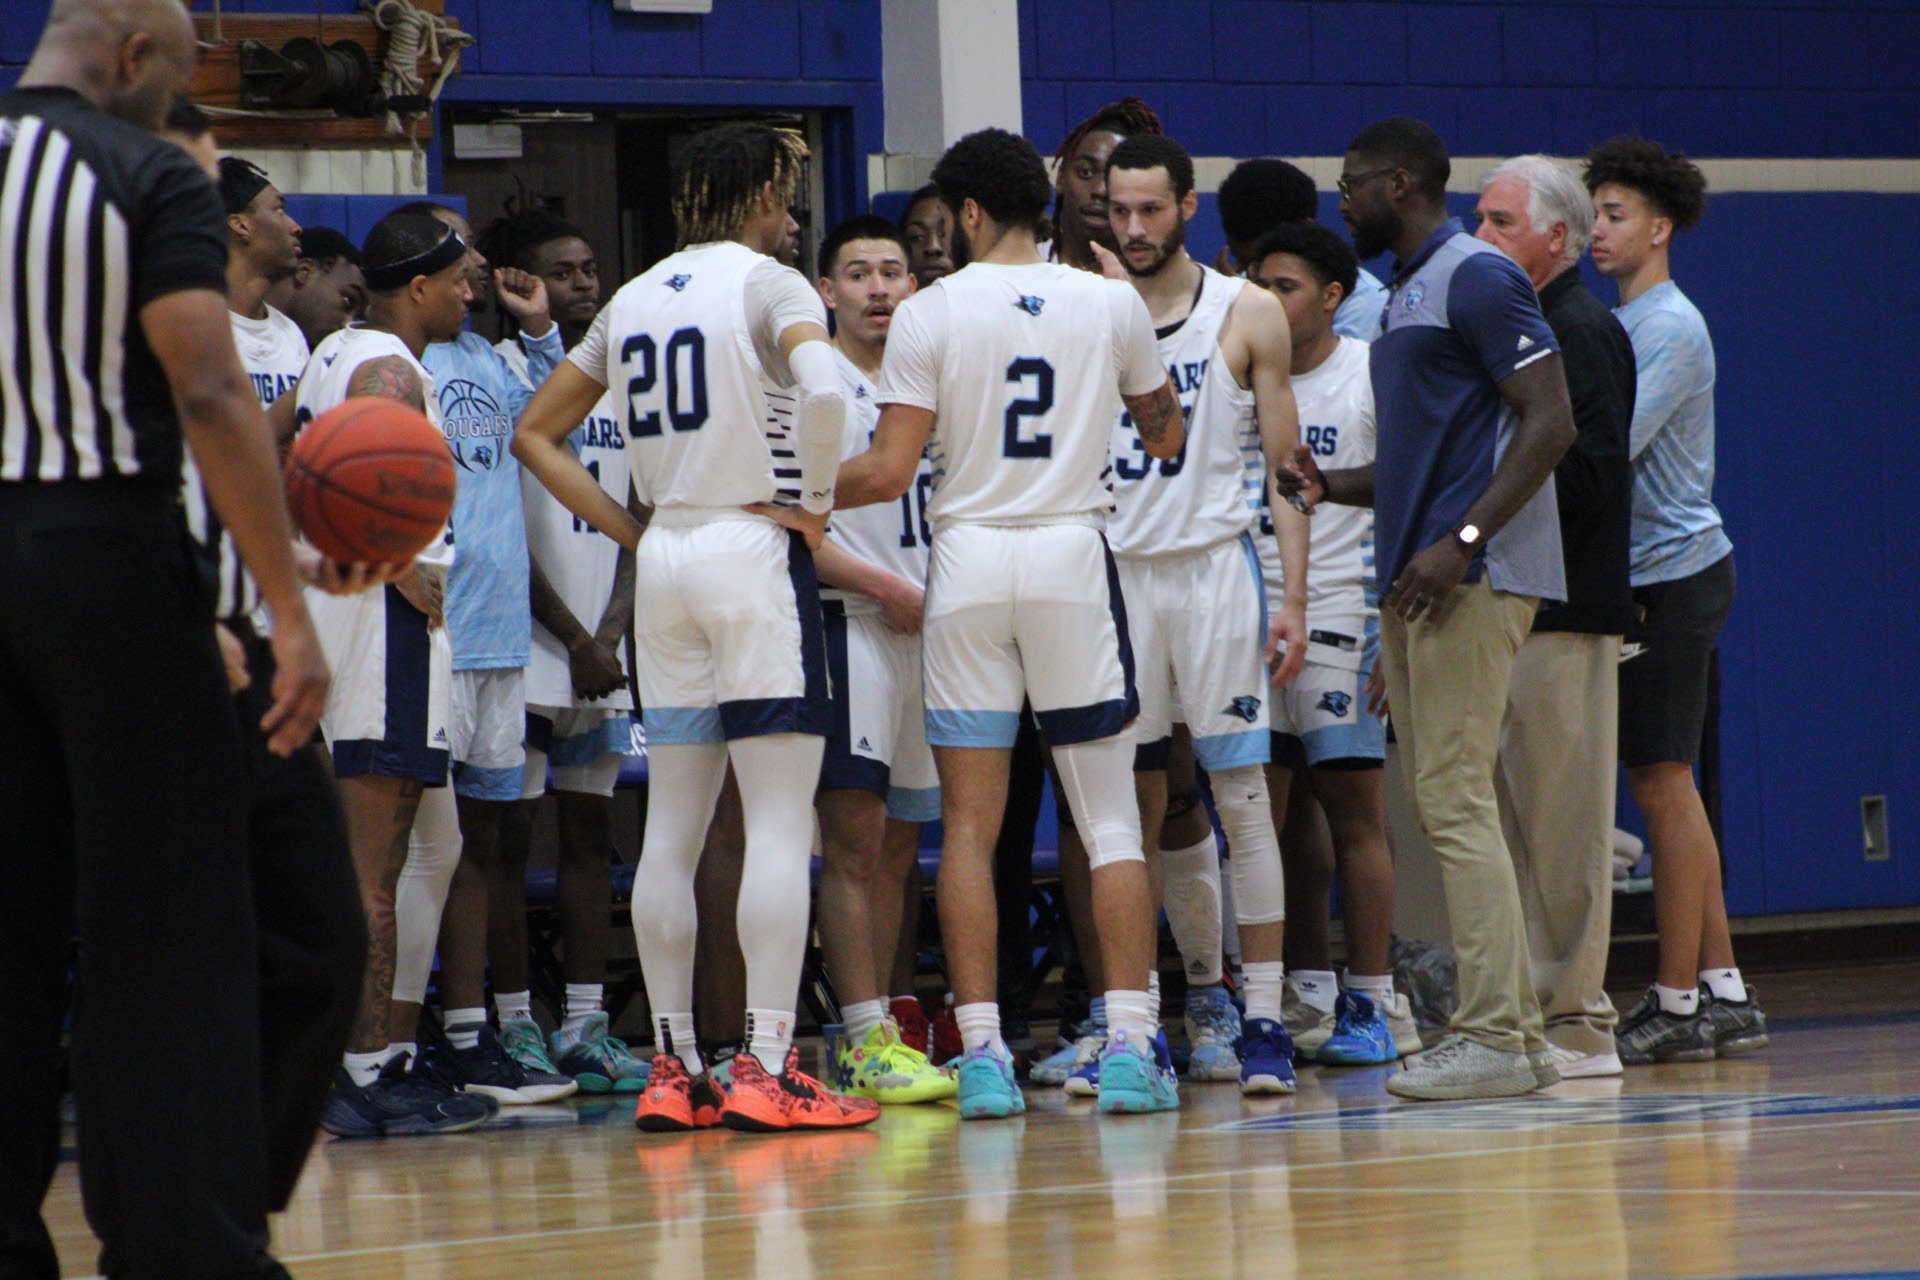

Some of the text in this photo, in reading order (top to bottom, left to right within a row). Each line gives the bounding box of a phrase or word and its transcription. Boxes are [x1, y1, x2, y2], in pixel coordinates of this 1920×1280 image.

[444, 415, 508, 440] OUGARS
[621, 326, 708, 438] 20
[1003, 357, 1054, 458] 2
